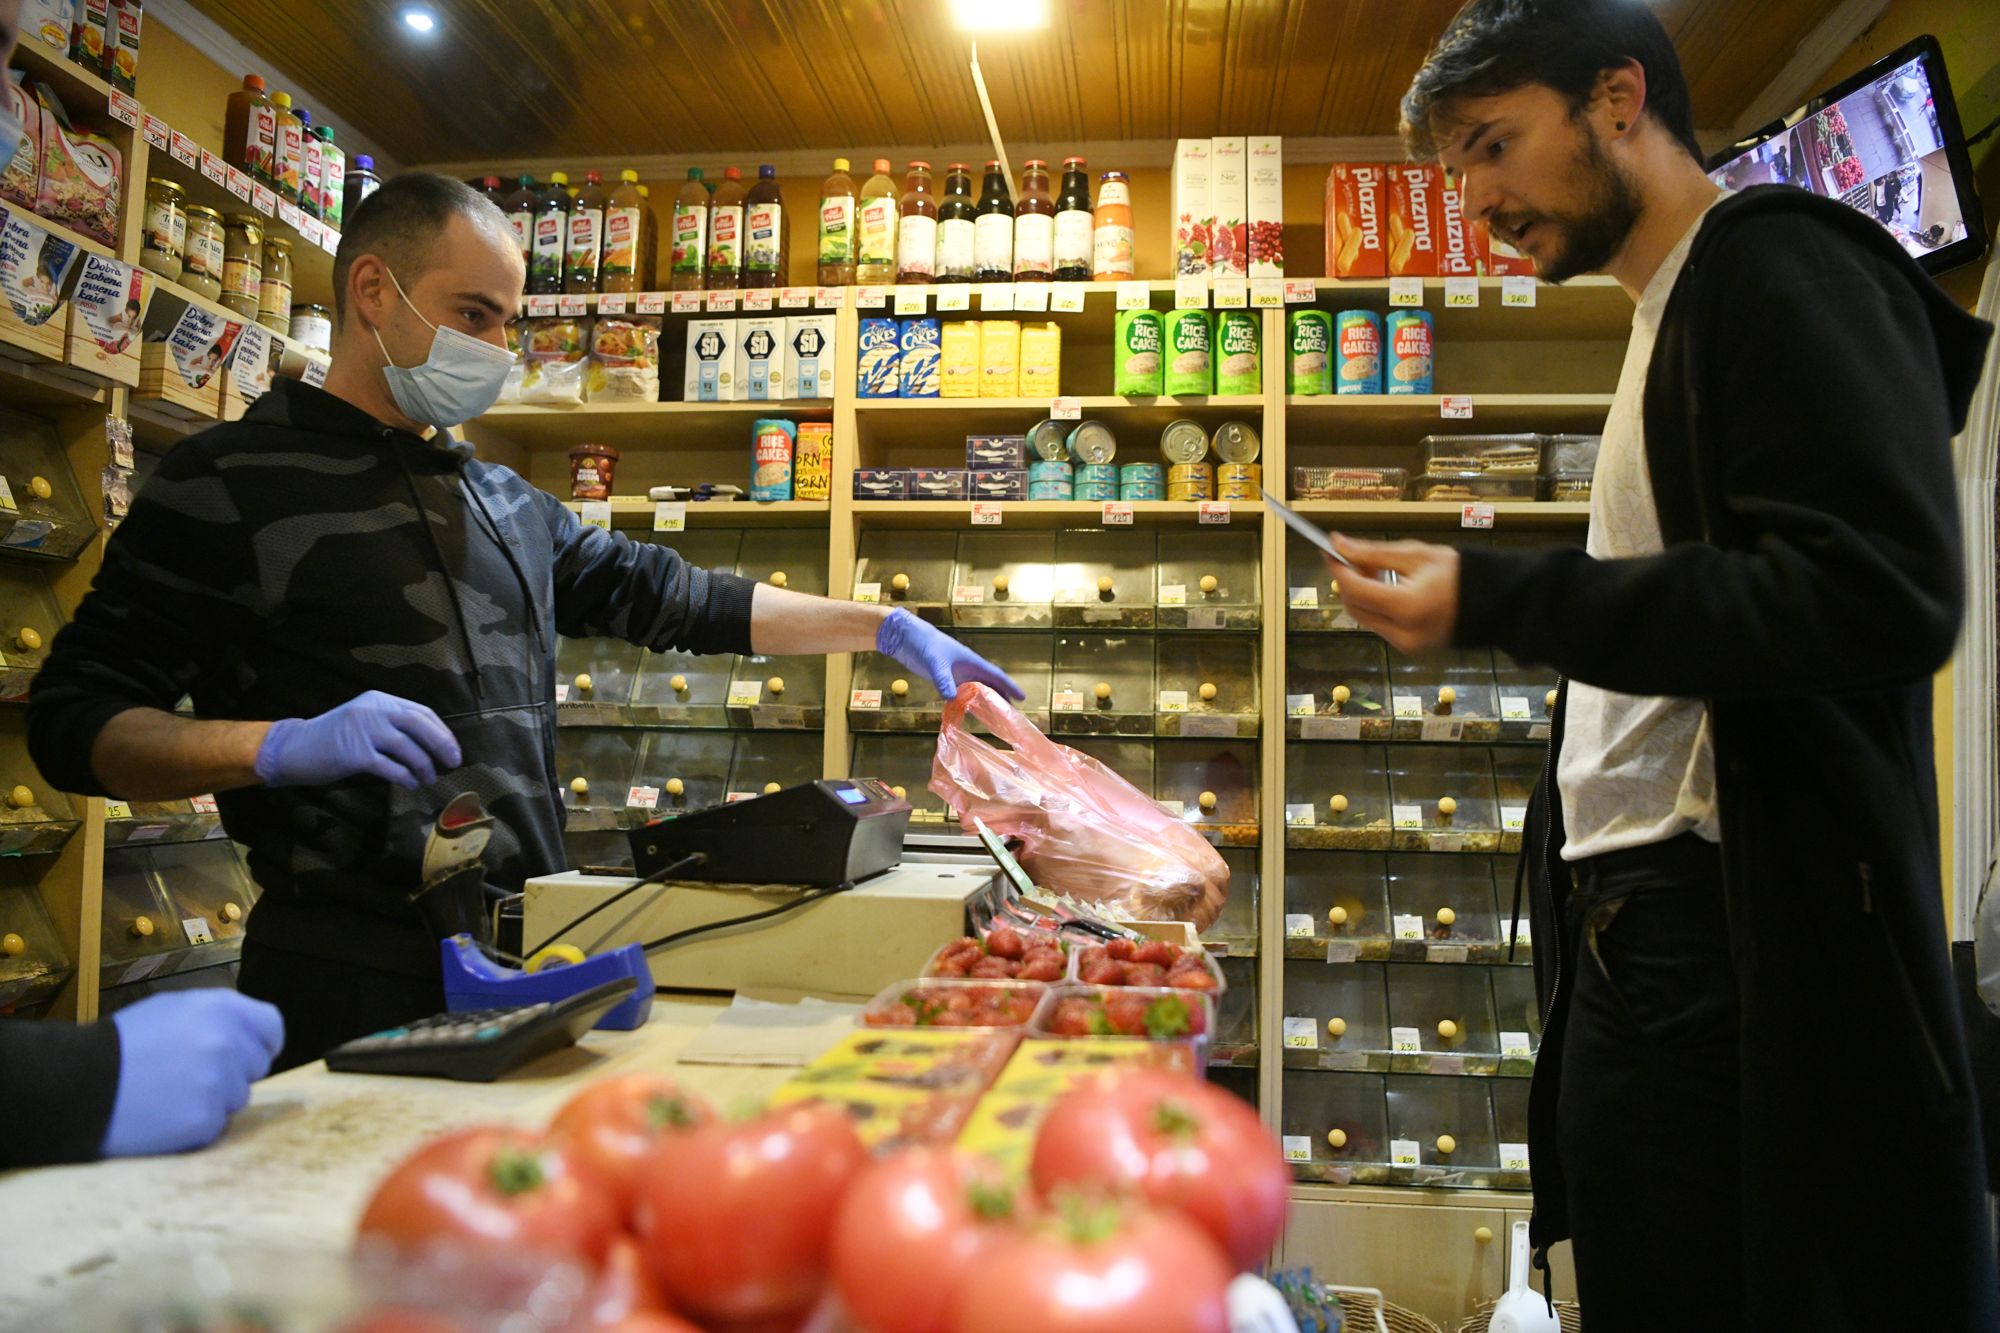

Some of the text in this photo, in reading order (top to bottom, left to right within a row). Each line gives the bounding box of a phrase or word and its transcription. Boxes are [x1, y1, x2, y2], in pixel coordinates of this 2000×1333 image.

[1351, 167, 1380, 250] plazma
[1403, 168, 1432, 251] plazma
[1442, 190, 1472, 273] plazma
[87, 256, 122, 276] Dobra
[84, 271, 122, 288] zobena
[80, 281, 121, 298] ovsena
[77, 289, 106, 305] kaša
[1184, 297, 1201, 306] 750
[1224, 297, 1242, 306] 825
[1399, 295, 1418, 304] 135
[1454, 295, 1473, 304] 135
[1511, 295, 1528, 303] 260
[1134, 324, 1159, 337] RICE
[1181, 324, 1207, 338] RICE
[1228, 326, 1253, 339] RICE
[1297, 325, 1324, 338] RICE
[1347, 327, 1373, 340] RICE
[1402, 328, 1427, 341] RICE
[171, 335, 197, 352] kaša
[859, 327, 897, 351] CAKES
[900, 327, 939, 351] CAKES
[1130, 336, 1162, 353] CAKES
[1176, 336, 1209, 352] CAKES
[1224, 338, 1257, 354] CAKES
[1293, 338, 1327, 353] CAKES
[1342, 341, 1378, 355] CAKES
[1396, 341, 1431, 355] CAKES
[1454, 408, 1466, 417] 75
[760, 435, 785, 448] RICE
[756, 448, 790, 462] CAKES
[795, 452, 821, 467] ORN
[109, 805, 121, 817] 25
[1293, 1036, 1308, 1046] 50
